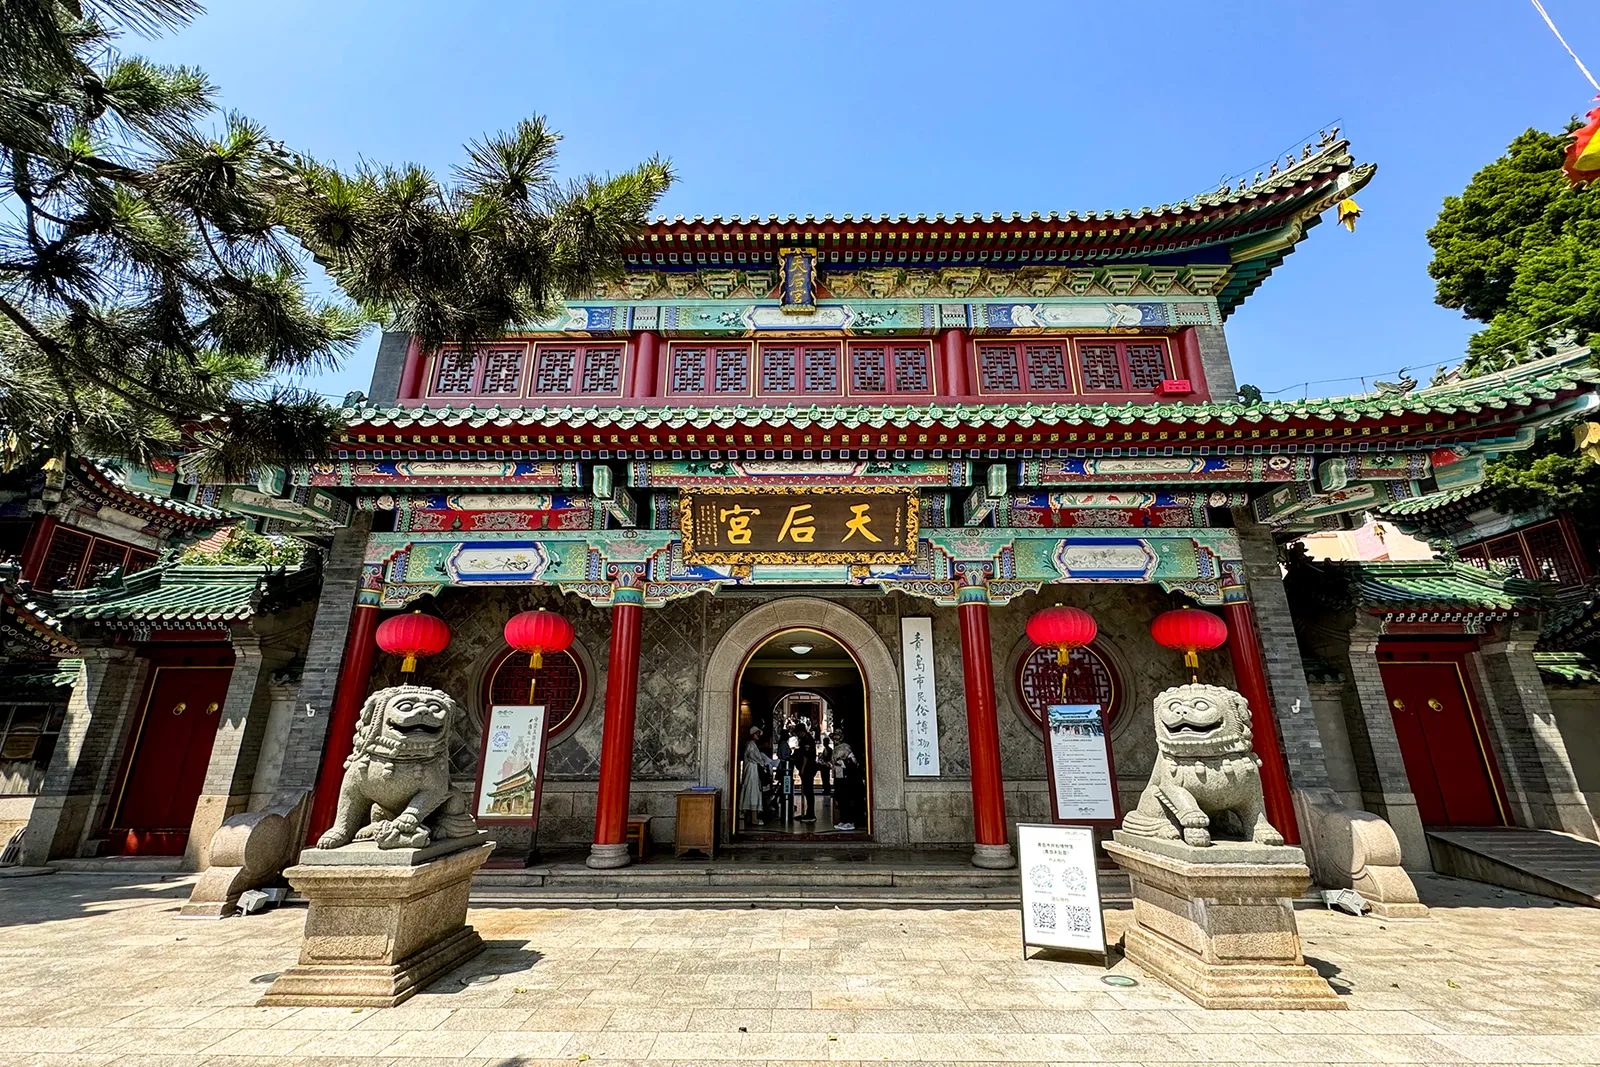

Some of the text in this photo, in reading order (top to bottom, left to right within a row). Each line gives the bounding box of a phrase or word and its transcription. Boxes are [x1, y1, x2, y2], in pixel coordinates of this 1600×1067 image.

[909, 631, 931, 766] 青岛市民俗博物馆
